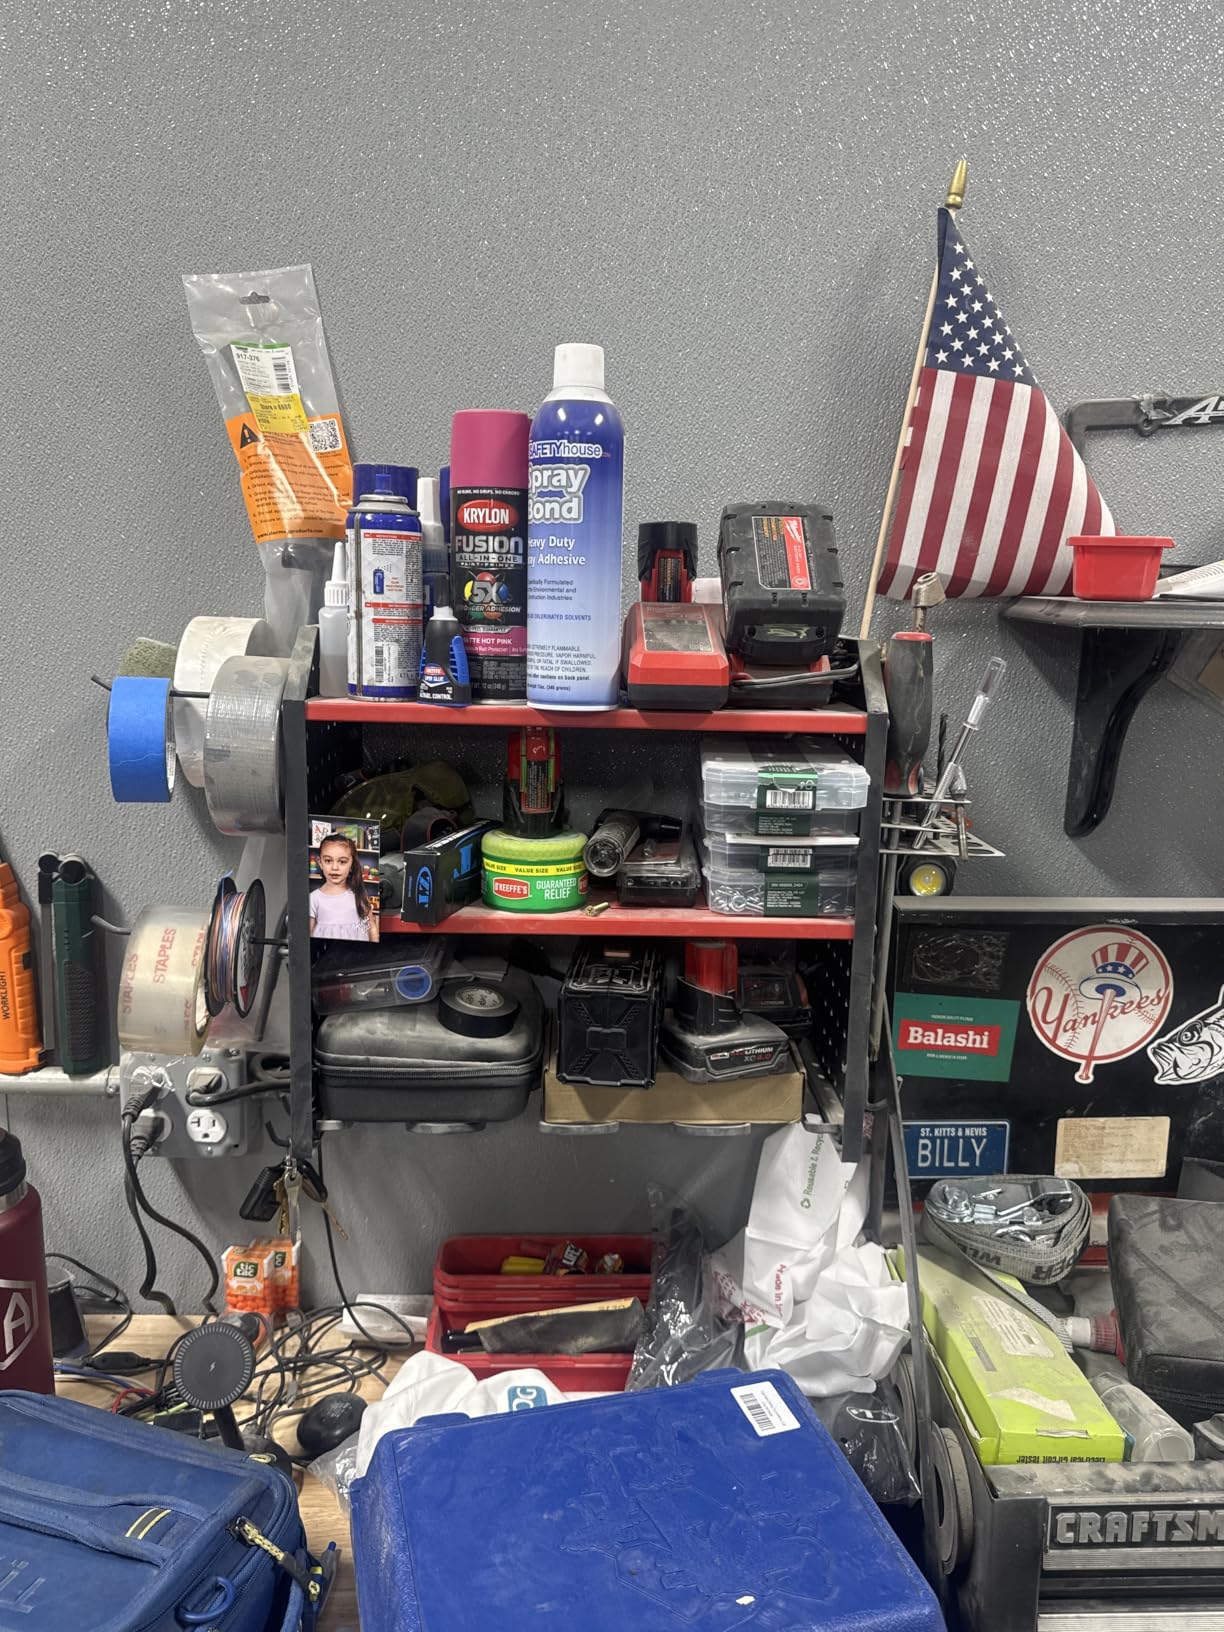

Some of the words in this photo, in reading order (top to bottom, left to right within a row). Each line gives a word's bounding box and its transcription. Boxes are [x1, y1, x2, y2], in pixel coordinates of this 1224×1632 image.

[463, 507, 509, 525] KRYLON
[455, 535, 523, 554] FUSION
[548, 536, 575, 550] Duty
[537, 553, 586, 565] Adhesive
[471, 581, 501, 604] 5X
[556, 865, 572, 873] VALUE
[494, 882, 528, 895] O'KEEFFE'S
[536, 878, 577, 890] GUARANTEED
[544, 888, 571, 900] RELIEF
[153, 928, 177, 984] STAPLES
[1031, 987, 1166, 1044] Yankees
[907, 1026, 990, 1049] Balashi
[920, 1127, 932, 1137] ST.
[934, 1127, 955, 1137] KITTS
[957, 1127, 963, 1137] &
[964, 1127, 988, 1137] NEVIS
[918, 1138, 987, 1168] BILLY
[803, 1162, 818, 1196] Reusable
[811, 1133, 824, 1156] Recyc
[236, 1268, 254, 1277] tac
[240, 1262, 256, 1270] tic
[775, 1292, 782, 1302] in
[1055, 1510, 1224, 1544] CRAFTSM
